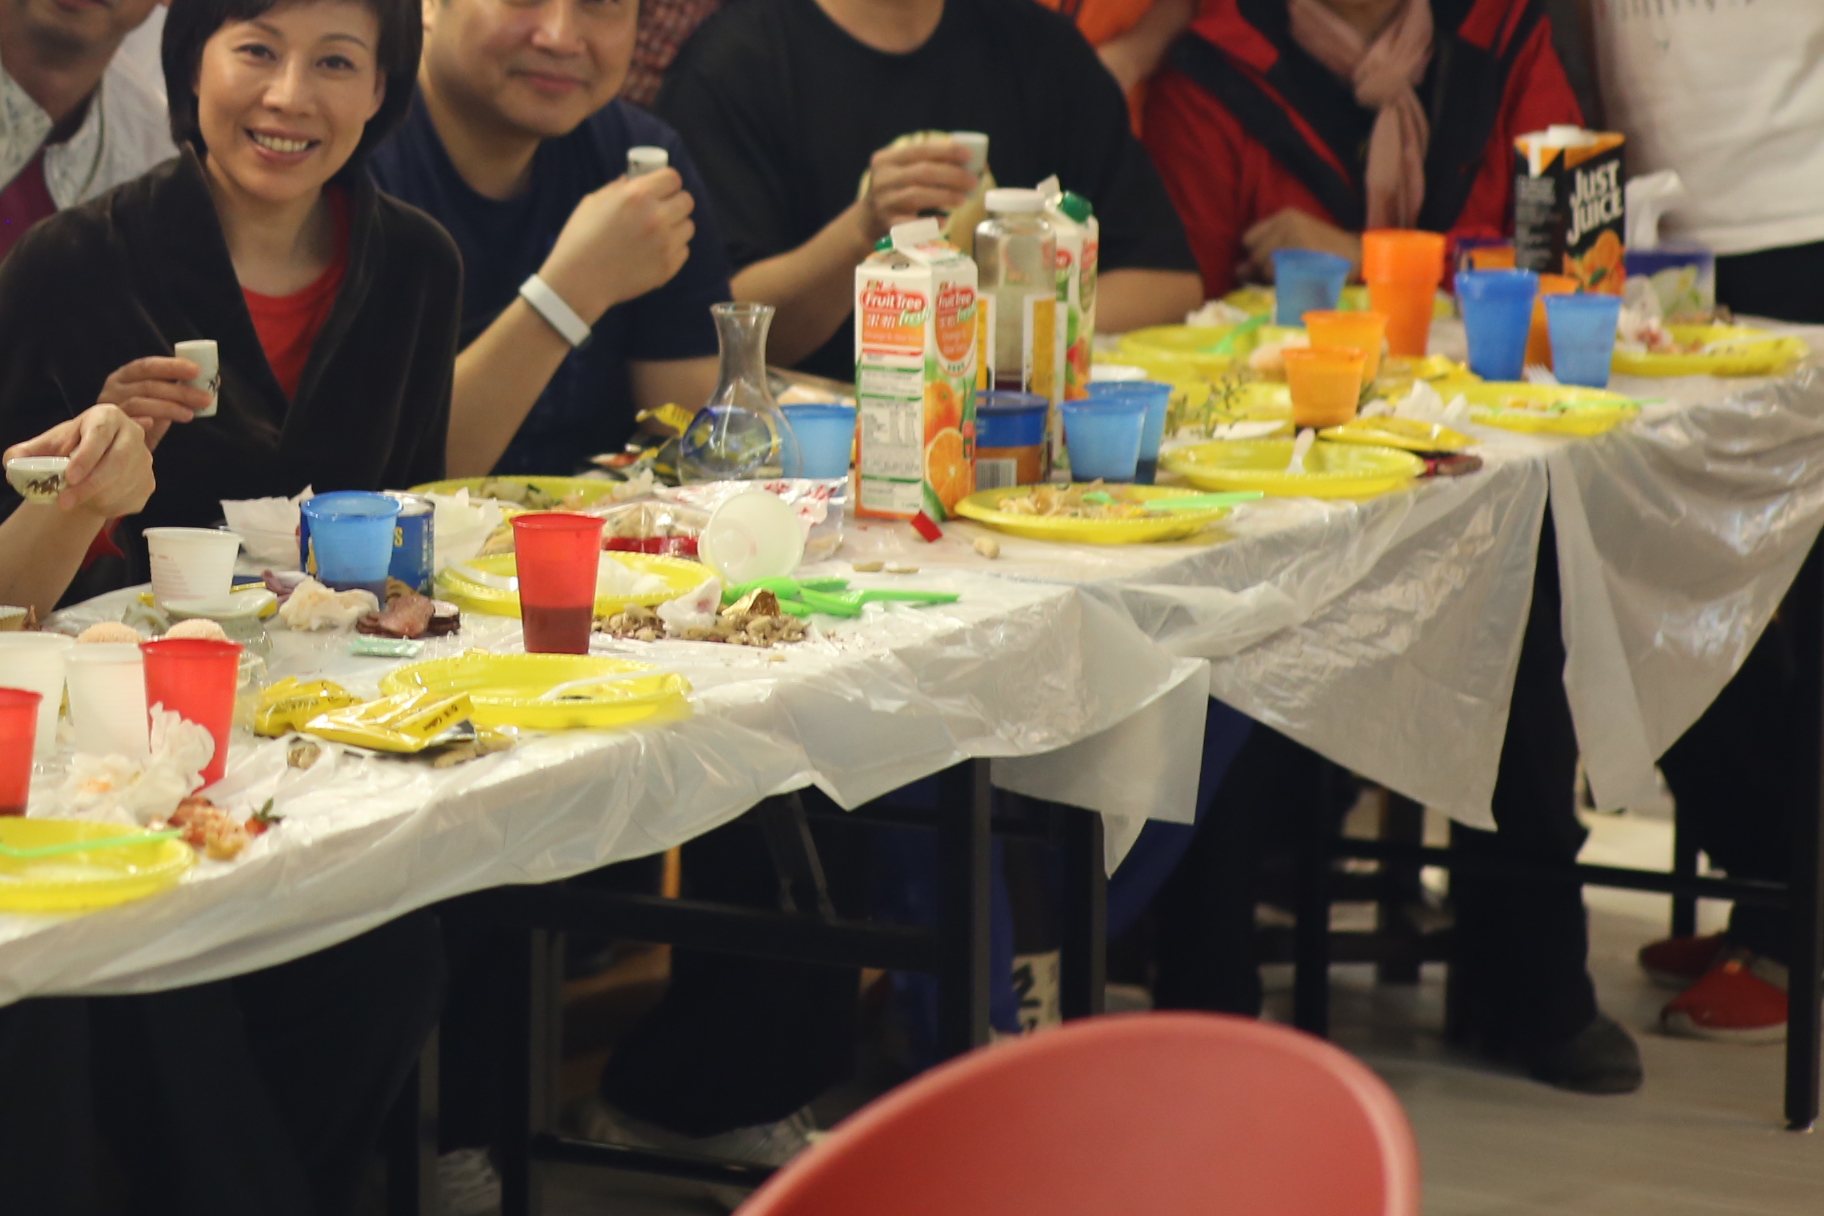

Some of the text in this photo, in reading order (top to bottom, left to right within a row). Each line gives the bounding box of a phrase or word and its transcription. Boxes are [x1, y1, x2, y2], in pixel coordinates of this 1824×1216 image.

[1569, 158, 1621, 207] JUST
[1566, 187, 1625, 246] JUICE
[865, 292, 922, 309] Fruit Tree
